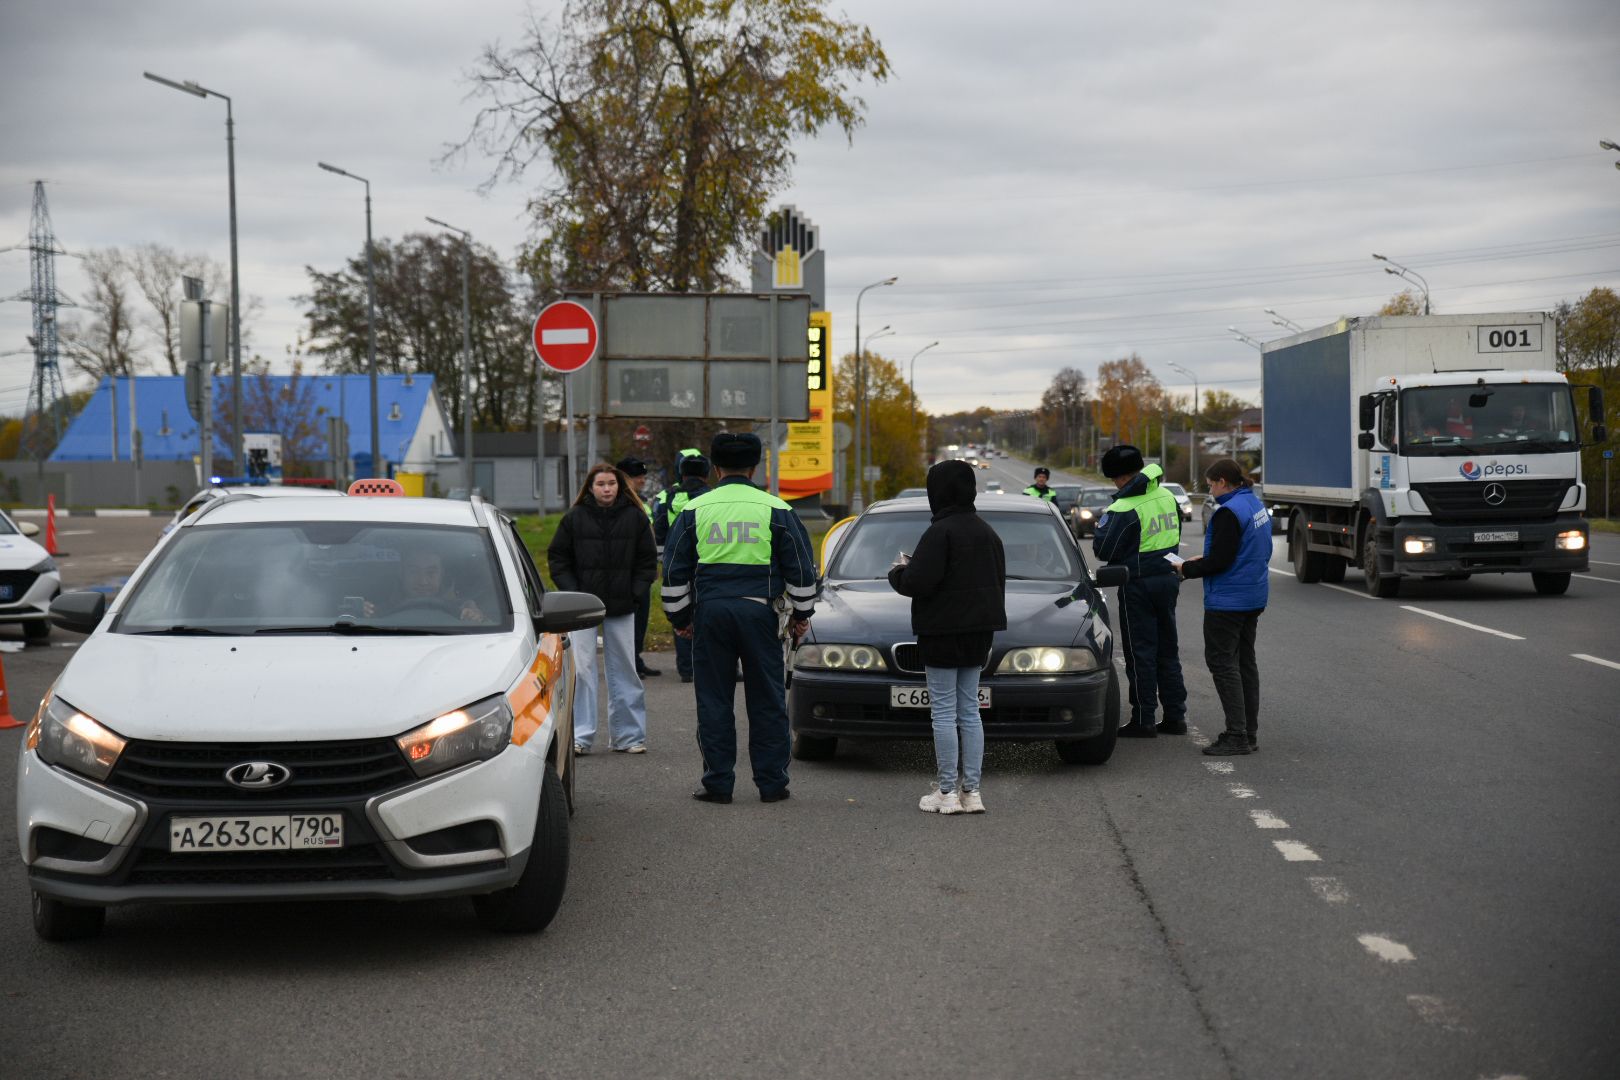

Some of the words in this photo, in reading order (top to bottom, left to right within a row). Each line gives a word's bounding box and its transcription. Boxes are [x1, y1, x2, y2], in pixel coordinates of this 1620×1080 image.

[1489, 330, 1531, 348] 001
[1484, 464, 1528, 477] pepsi
[706, 521, 760, 544] ДПС
[1147, 511, 1178, 536] ДПС
[180, 820, 286, 848] А263СК
[292, 817, 334, 838] 790
[303, 837, 324, 846] RUS
